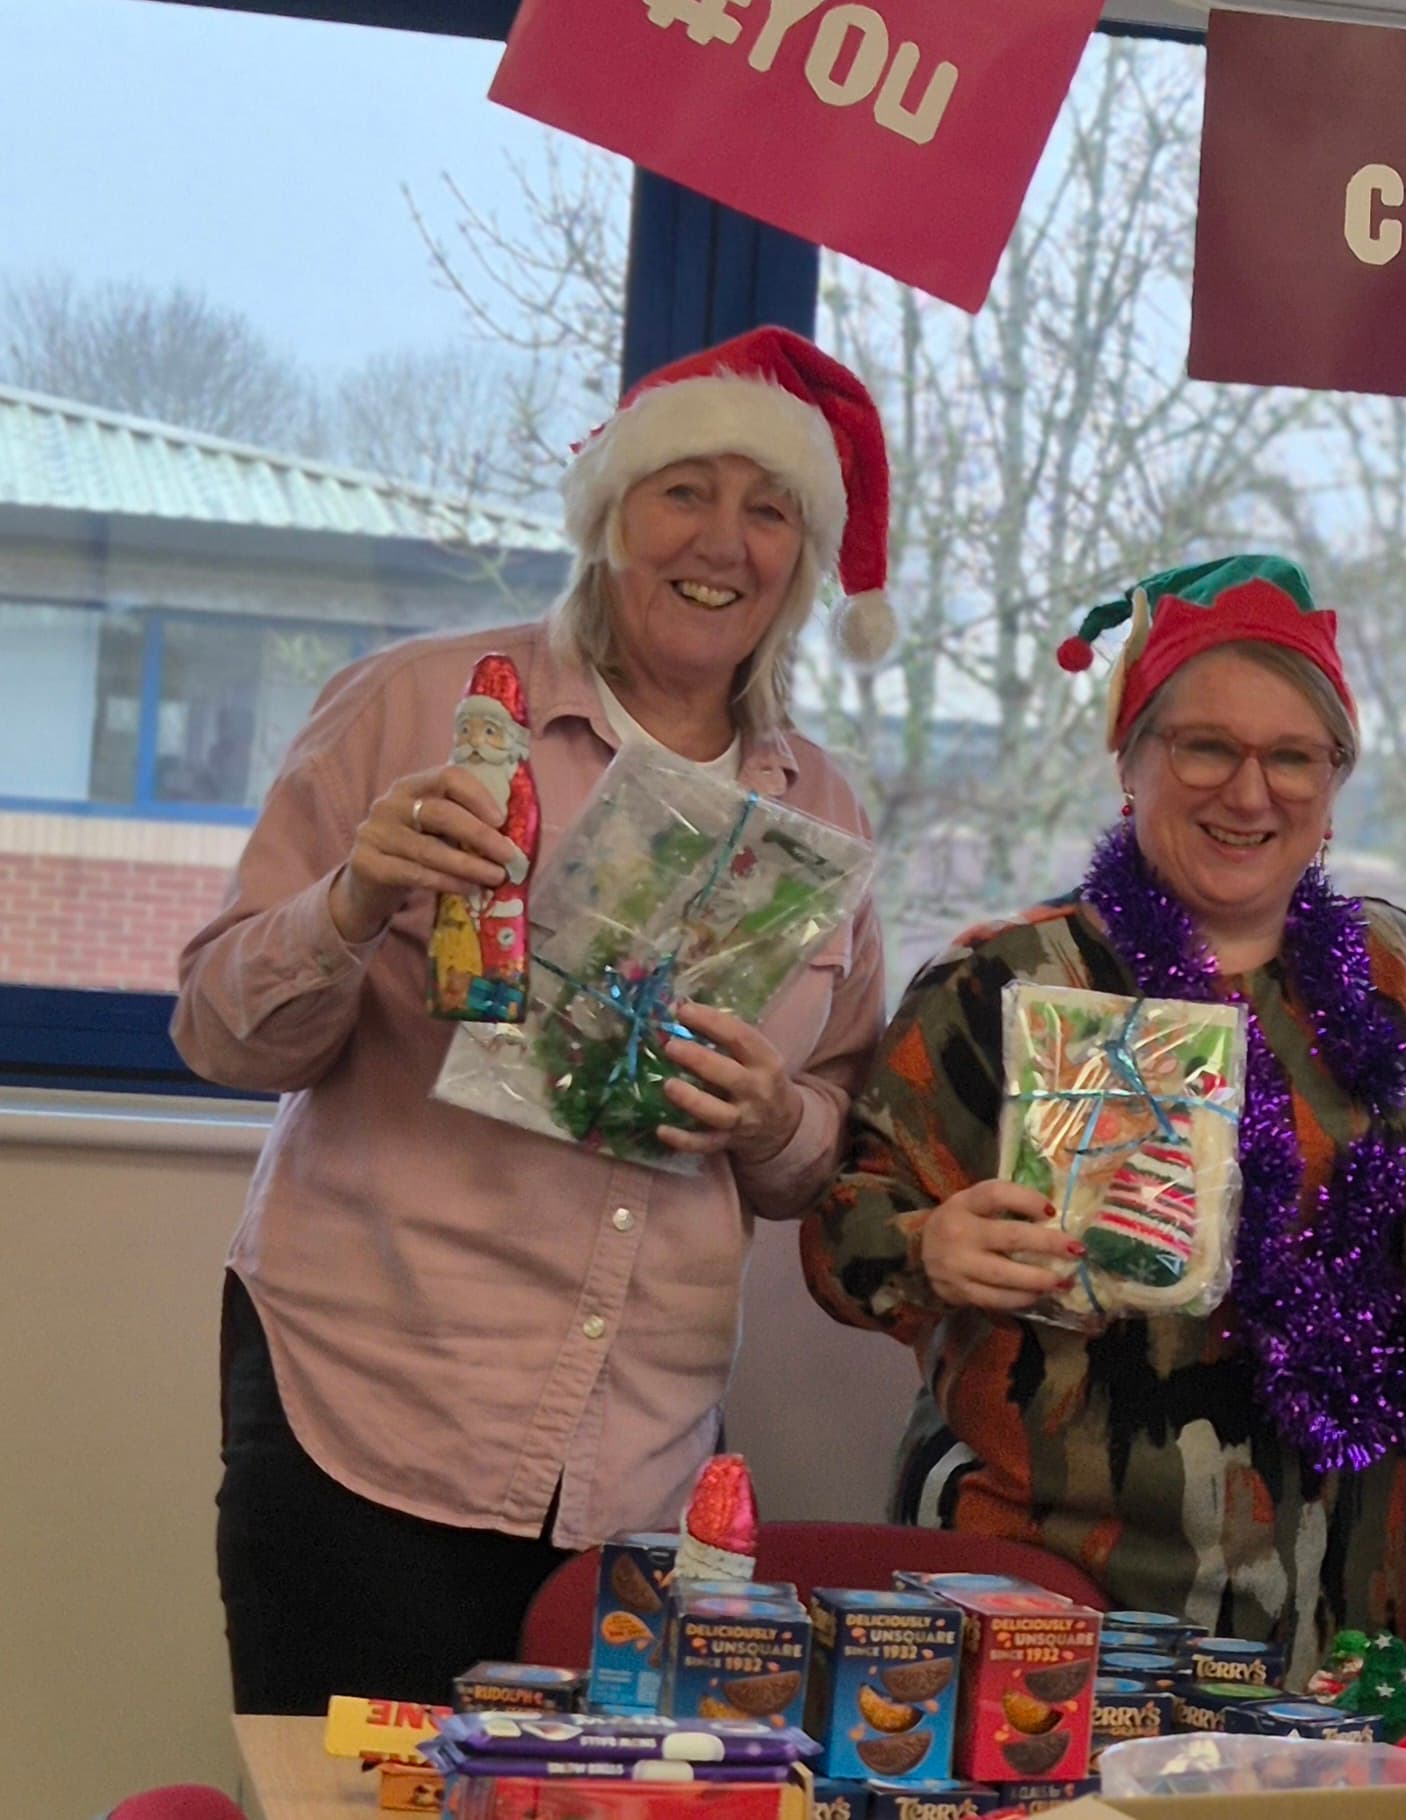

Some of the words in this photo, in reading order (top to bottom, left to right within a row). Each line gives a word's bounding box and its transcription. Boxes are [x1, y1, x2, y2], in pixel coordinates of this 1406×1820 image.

[846, 1613, 932, 1627] DELICIOUSLY
[991, 1618, 1074, 1631] DELICIOUSLY
[685, 1623, 778, 1640] DELICIOUSLY
[870, 1629, 956, 1644] UNSQUARE
[1014, 1632, 1095, 1647] UNSQUARE
[712, 1640, 803, 1658] UNSQUARE
[883, 1645, 919, 1659] 1932
[1026, 1648, 1059, 1662] 1932
